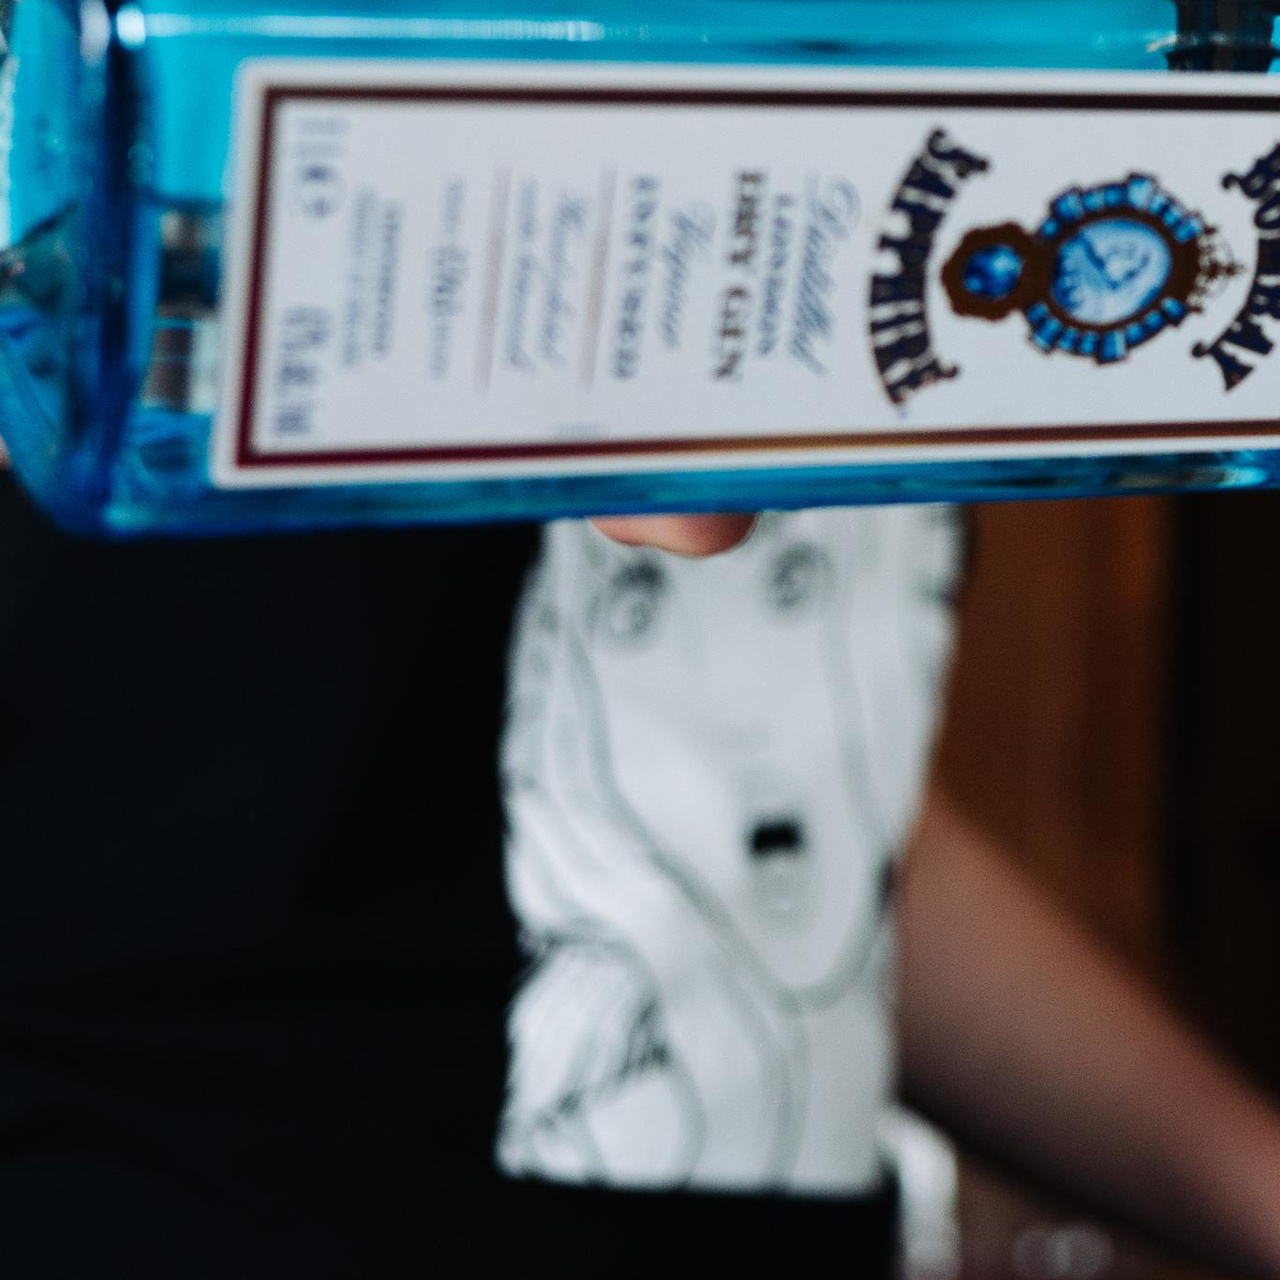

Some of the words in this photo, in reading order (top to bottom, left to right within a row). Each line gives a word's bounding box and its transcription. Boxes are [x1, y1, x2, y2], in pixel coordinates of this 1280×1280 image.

[726, 169, 766, 266] DRY
[868, 127, 991, 406] SAPPHIRE
[709, 285, 752, 382] GIN
